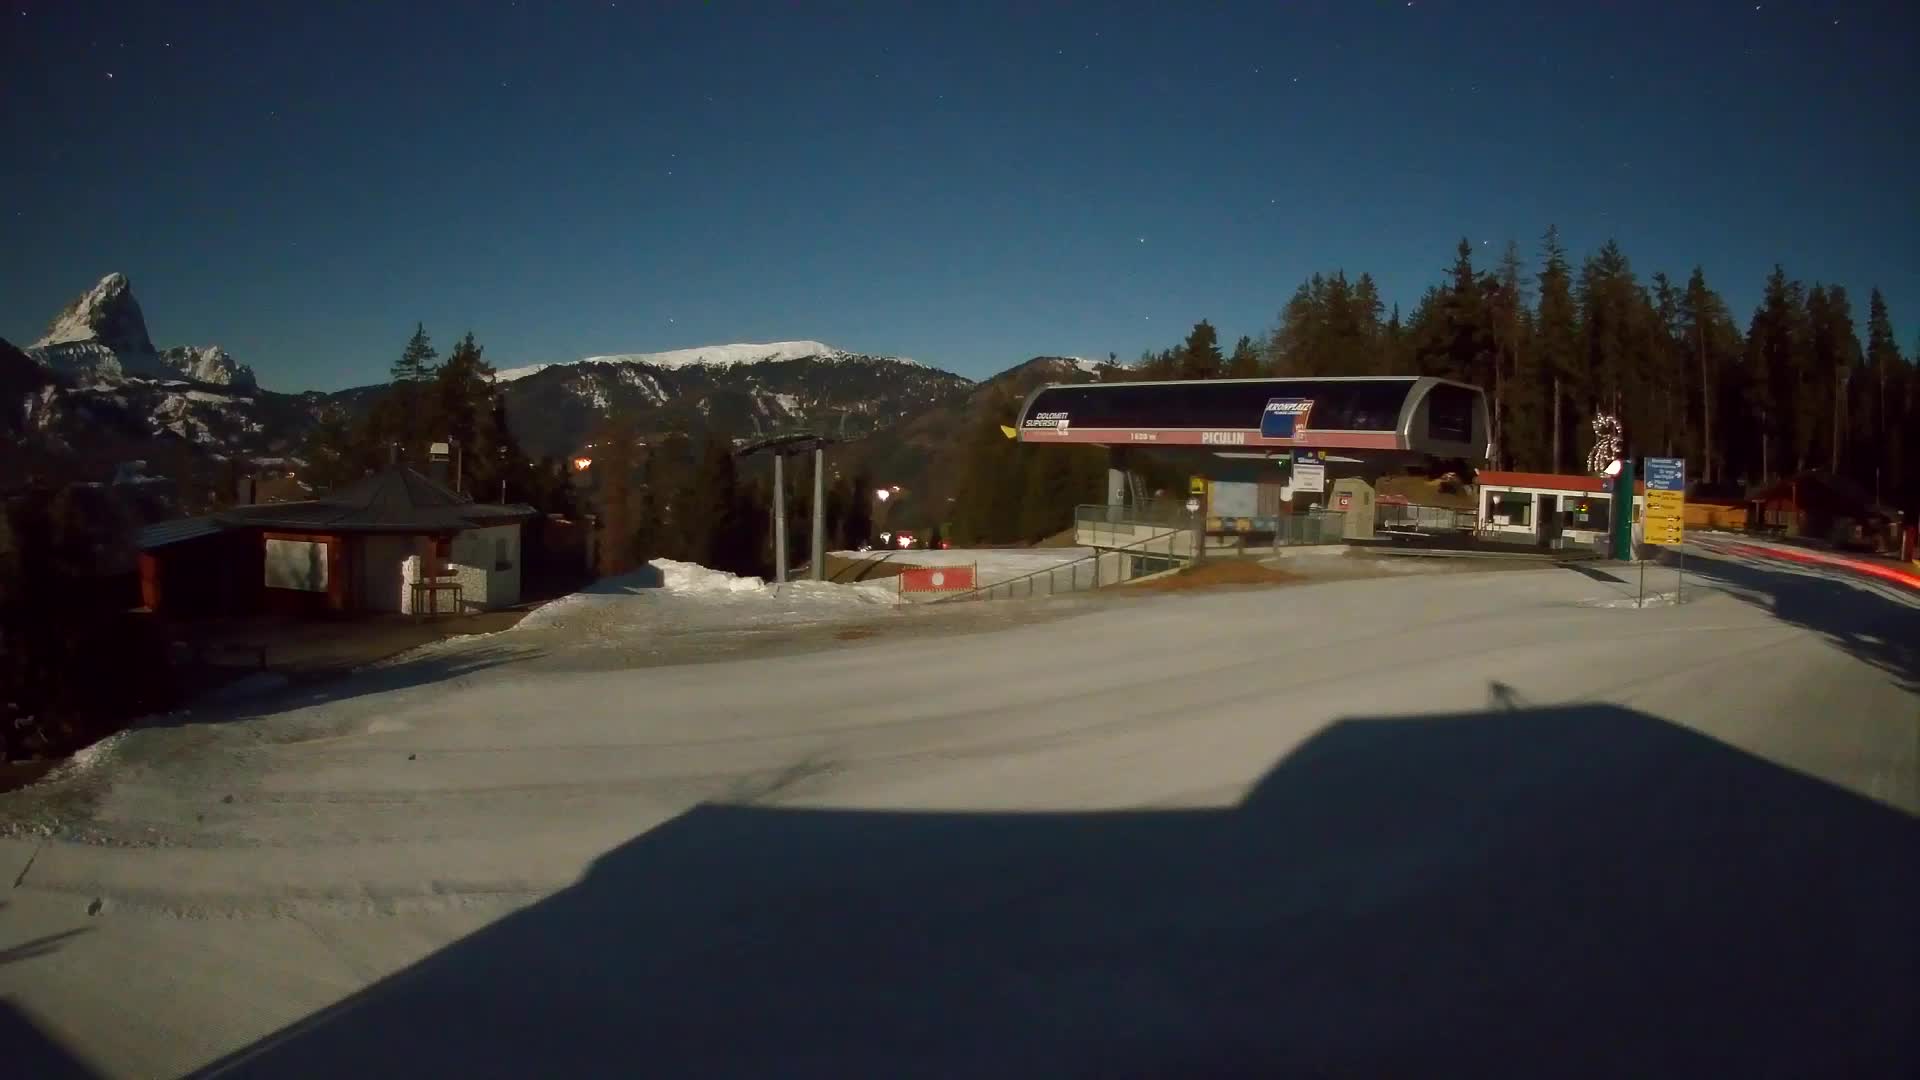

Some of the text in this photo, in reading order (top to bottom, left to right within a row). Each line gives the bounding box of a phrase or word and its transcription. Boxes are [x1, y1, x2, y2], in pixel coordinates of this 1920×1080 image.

[1267, 403, 1311, 411] KRONPLATZ
[1036, 412, 1069, 420] DOLOMITI
[1025, 419, 1059, 427] SUPERSKI
[1202, 431, 1245, 445] PICULIN
